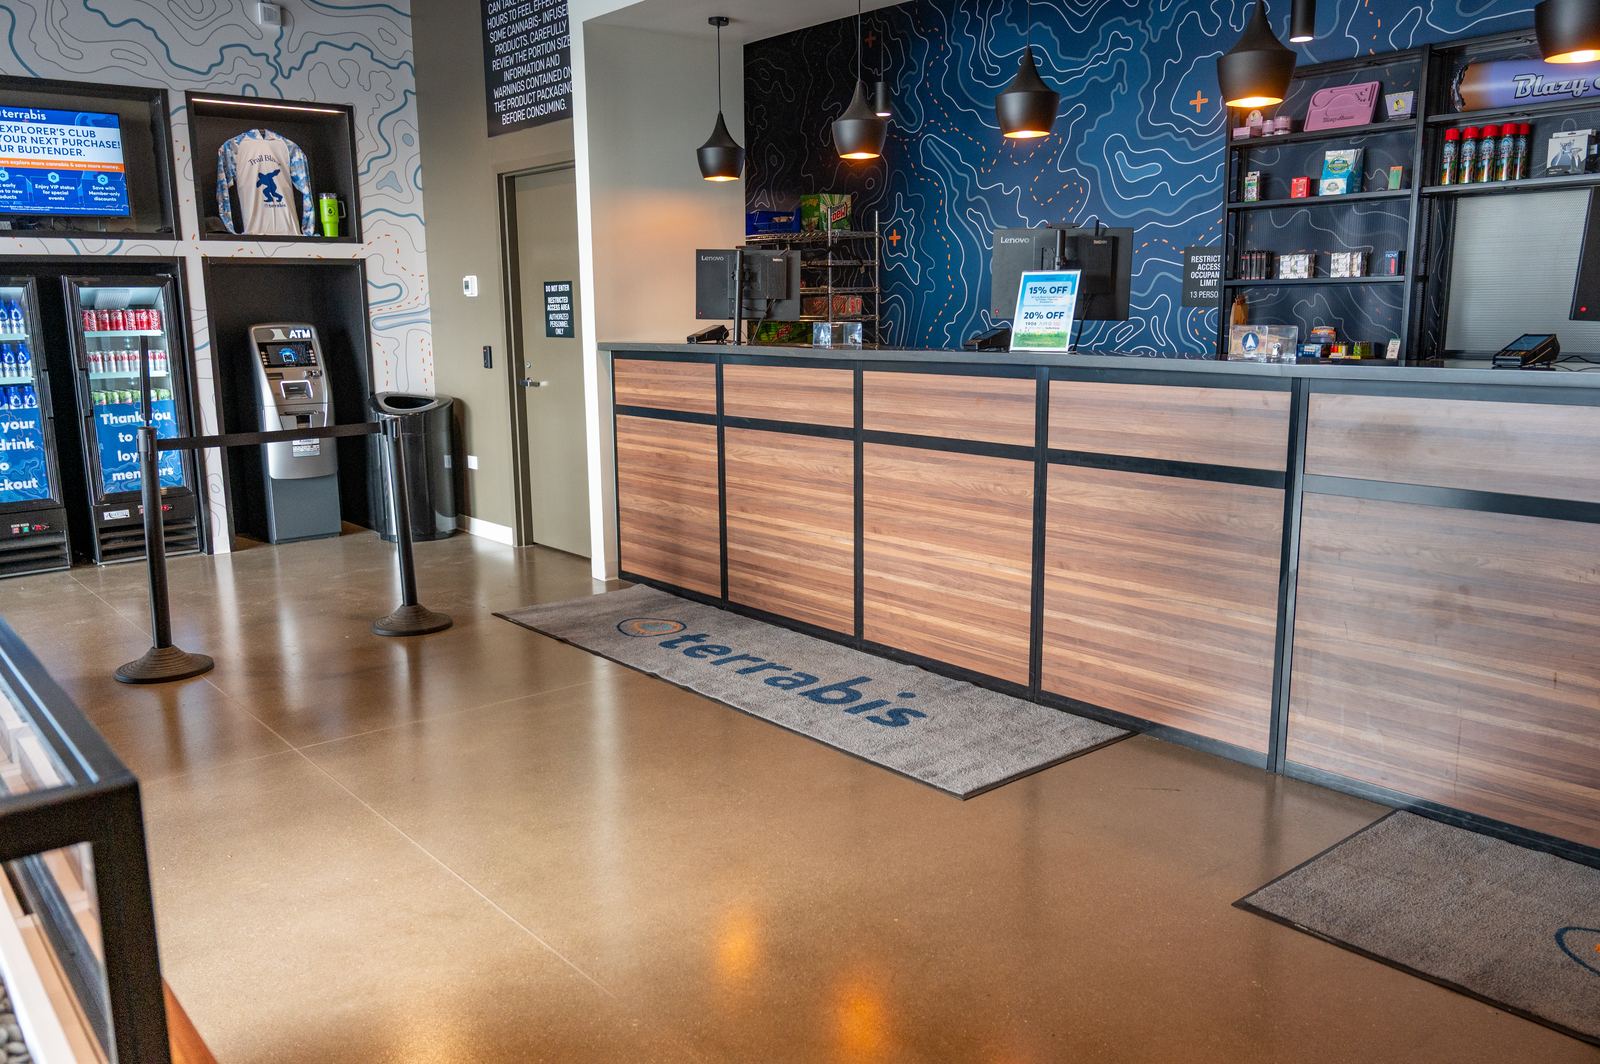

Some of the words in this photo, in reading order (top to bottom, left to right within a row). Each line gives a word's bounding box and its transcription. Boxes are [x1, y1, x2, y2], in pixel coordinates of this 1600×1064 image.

[488, 0, 501, 14] CAN
[487, 12, 508, 30] HOURS
[508, 9, 517, 21] TO
[517, 3, 533, 18] FEEL
[534, 0, 562, 12] EFFEC
[489, 27, 506, 43] SOME
[542, 4, 569, 24] INFUSE
[494, 34, 529, 56] PRODUCTS.
[529, 20, 567, 44] CAREFULLY
[492, 54, 514, 71] REVIEW
[515, 49, 527, 63] THE
[528, 39, 556, 60] PORTION
[557, 34, 571, 50] SIZE
[503, 58, 545, 82] INFORMATION
[545, 53, 560, 69] AND
[493, 80, 526, 99] WARNINGS
[525, 68, 562, 90] CONTAINED
[563, 65, 572, 79] ON
[1512, 72, 1590, 99] Blazy
[494, 100, 506, 113] THE
[506, 91, 536, 110] PRODUCT
[537, 81, 572, 101] PACKAGING
[2, 109, 47, 120] terrabis
[502, 109, 526, 126] BEFORE
[526, 98, 567, 119] CONSUMING.
[0, 124, 65, 136] EXPLORER'S
[68, 129, 96, 138] CLUB
[31, 136, 59, 145] NEXT
[62, 138, 121, 149] PURCHASE!
[18, 145, 86, 157] BUDTENDER.
[1000, 236, 1030, 244] Lenovo
[1190, 254, 1221, 263] RESTRICT
[1196, 263, 1221, 271] ACCESS
[1190, 271, 1220, 279] OCCUPAN
[1199, 279, 1218, 287] LIMIT
[1029, 286, 1047, 294] 15%
[1049, 286, 1068, 294] OFF
[1198, 291, 1219, 299] PERSO
[1023, 311, 1044, 320] 20%
[1045, 311, 1065, 319] OFF
[289, 329, 311, 339] ATM
[100, 411, 144, 425] Thank
[1, 420, 35, 433] your
[118, 432, 133, 443] to
[117, 450, 164, 463] loyy
[112, 467, 174, 481] memrs
[659, 633, 927, 728] terrabis
